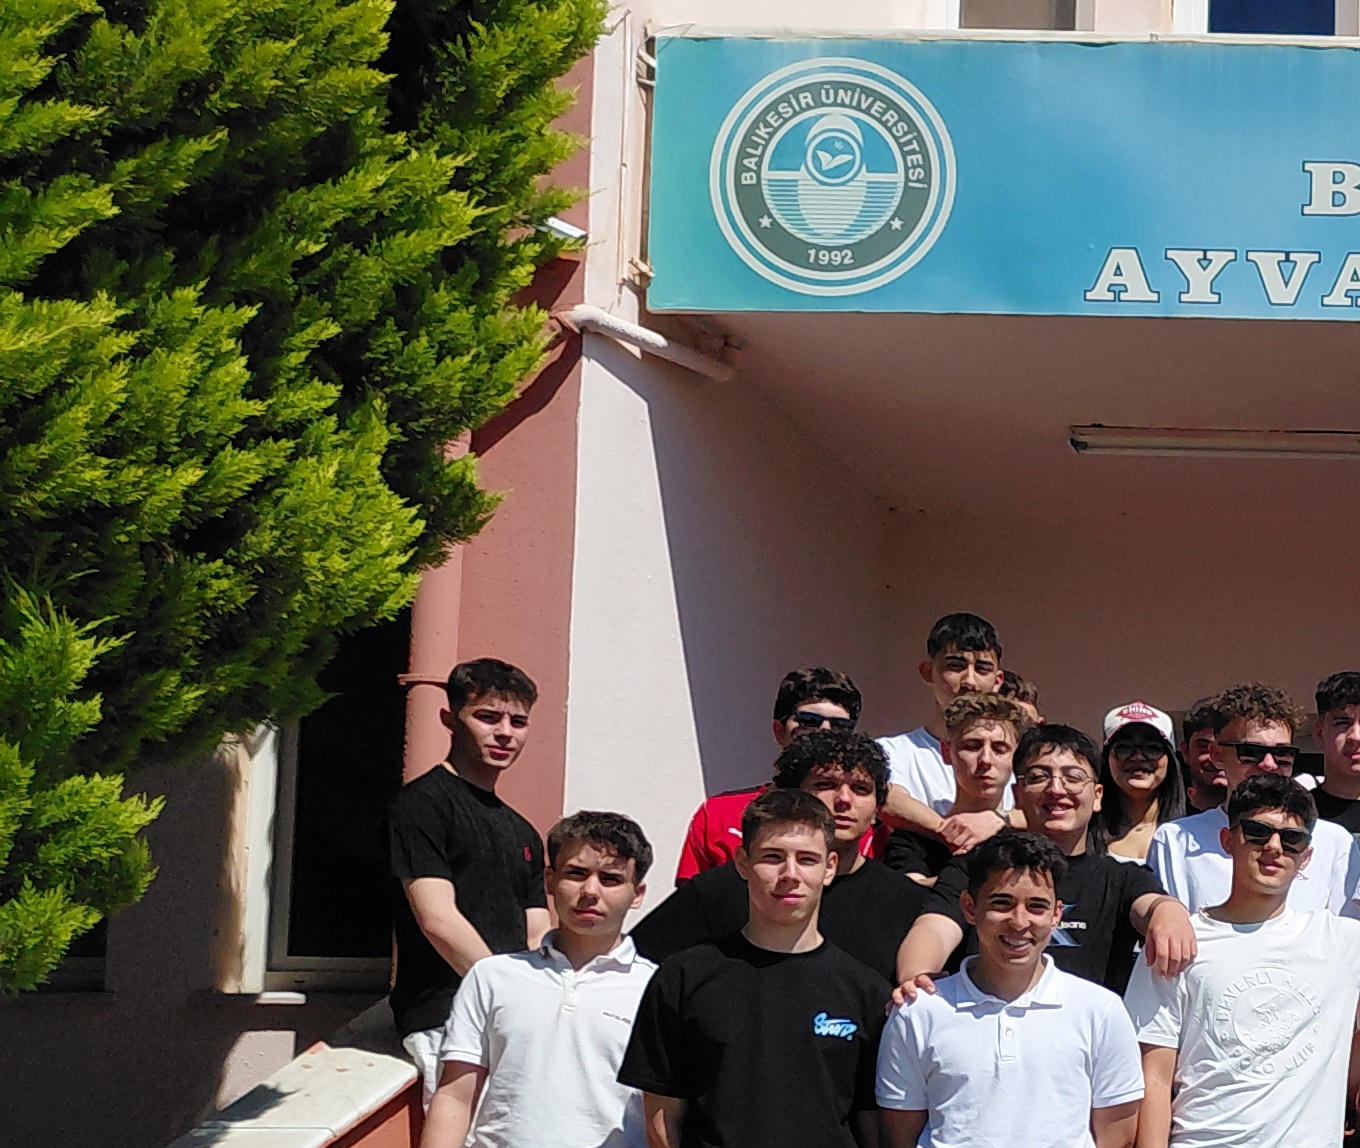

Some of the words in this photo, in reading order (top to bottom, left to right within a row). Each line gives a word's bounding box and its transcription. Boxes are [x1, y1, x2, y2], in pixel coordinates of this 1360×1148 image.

[741, 91, 815, 185] BALIKESİR
[820, 84, 929, 189] ÜNİVERSİTESİ
[807, 249, 854, 266] 1992
[1215, 971, 1273, 1022] BEVERLY
